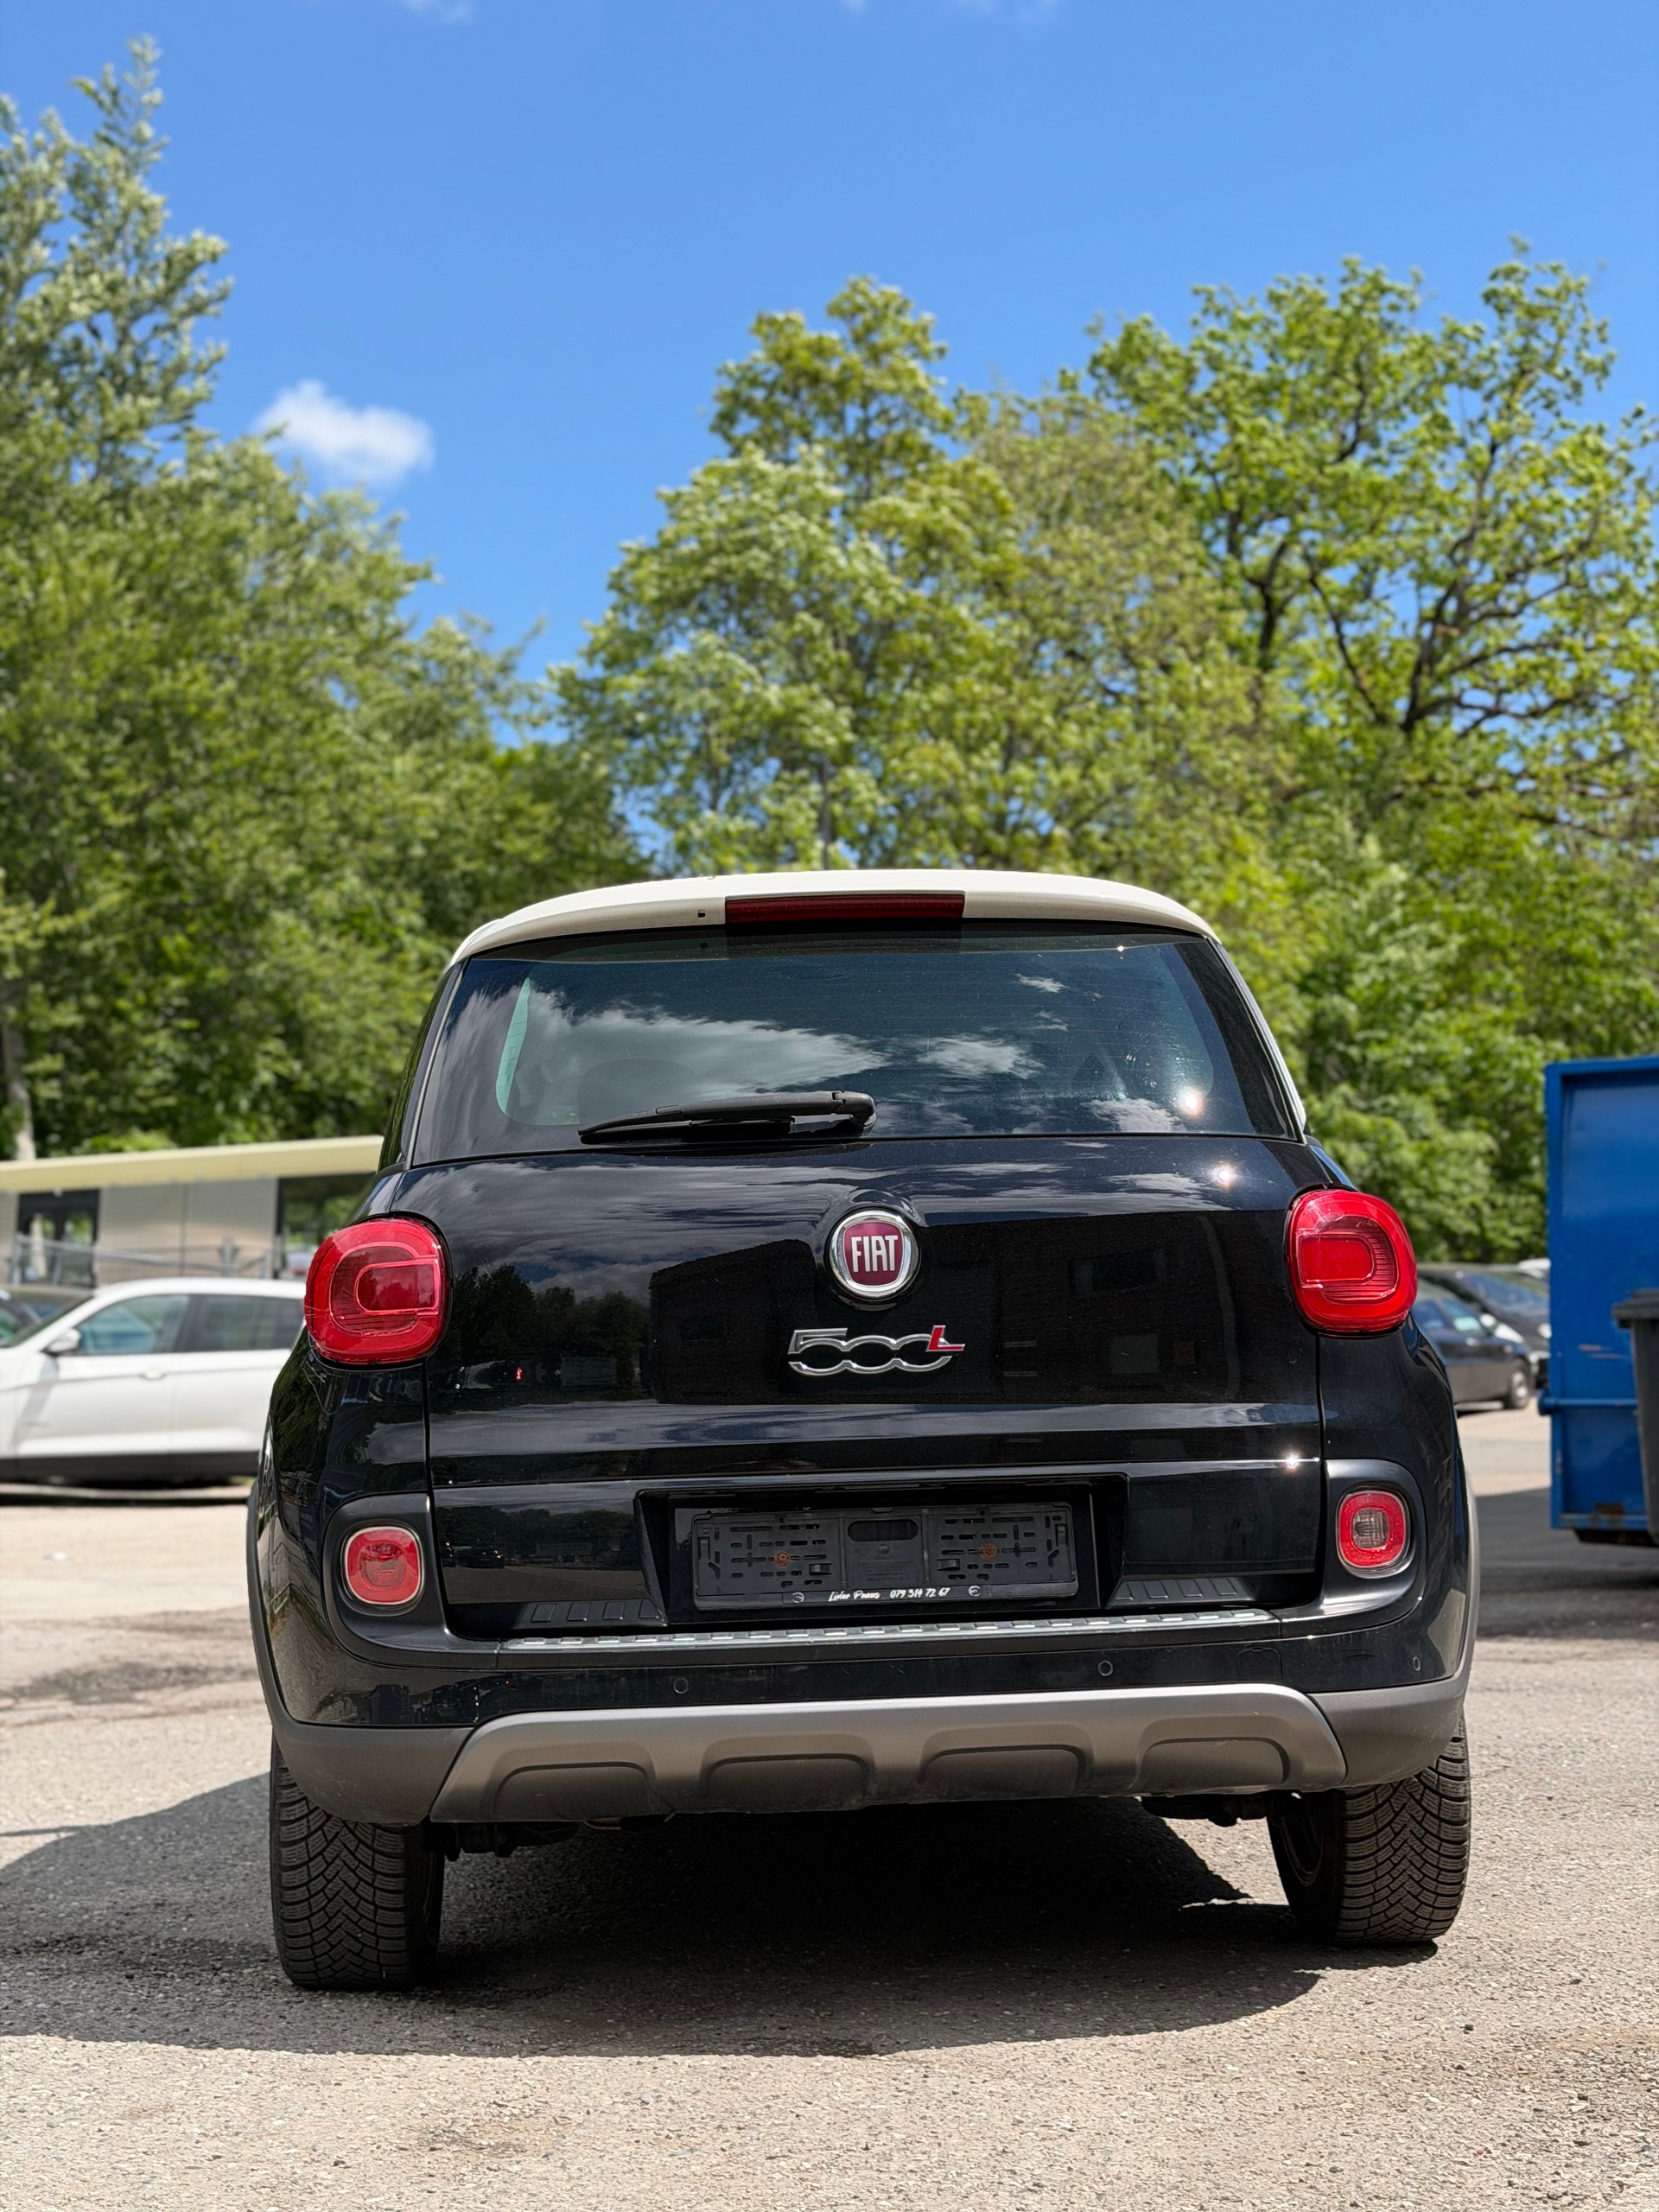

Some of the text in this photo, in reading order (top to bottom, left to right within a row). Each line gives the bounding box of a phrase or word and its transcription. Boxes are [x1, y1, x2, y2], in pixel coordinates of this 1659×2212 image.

[850, 1235, 899, 1273] FIAT
[787, 1325, 966, 1376] 500L
[853, 1590, 880, 1600] Pneus
[889, 1589, 906, 1599] 079
[907, 1588, 923, 1599] 314
[925, 1588, 937, 1598] 72
[938, 1587, 950, 1597] 67
